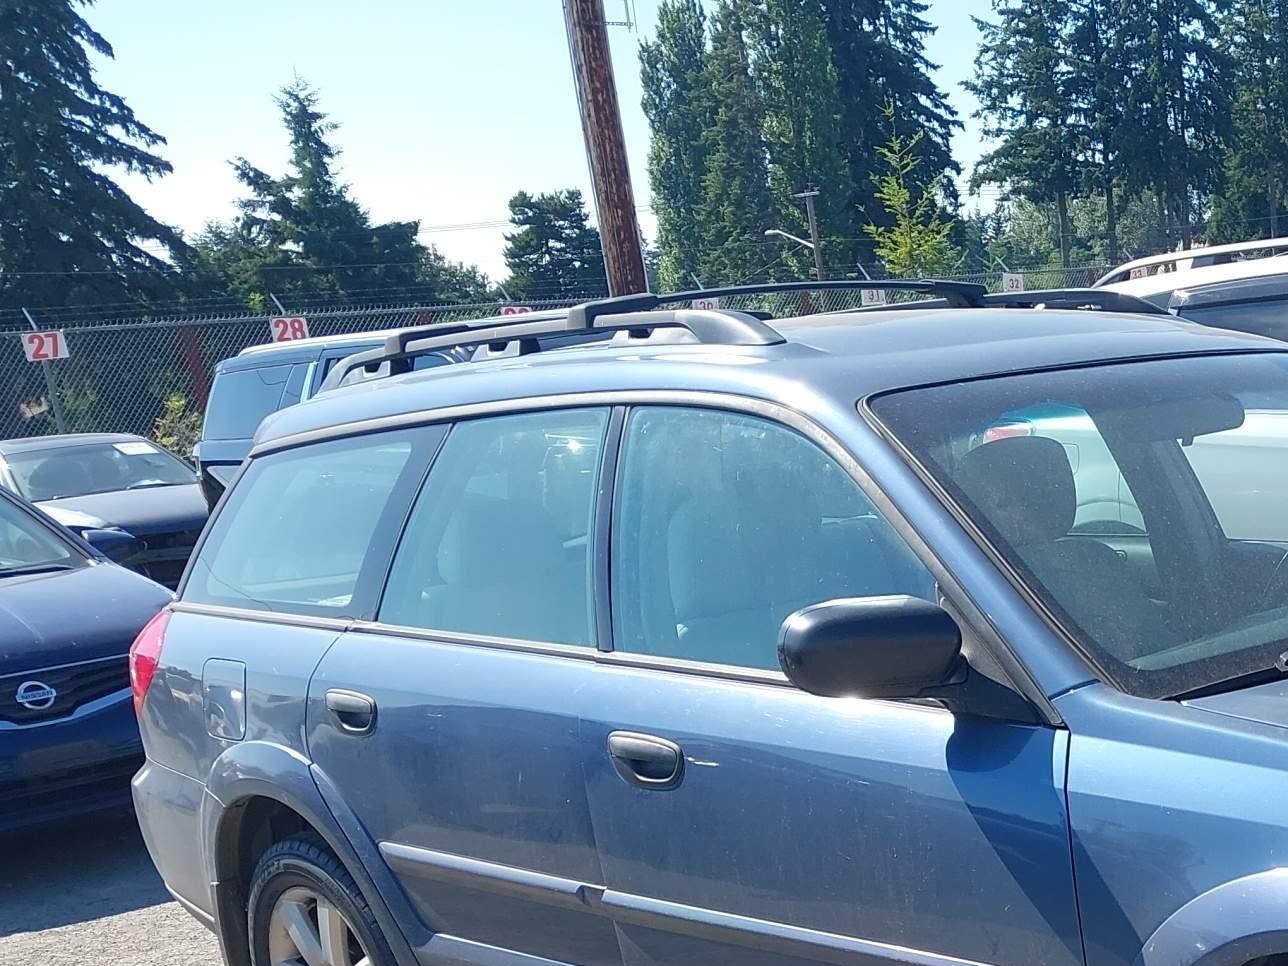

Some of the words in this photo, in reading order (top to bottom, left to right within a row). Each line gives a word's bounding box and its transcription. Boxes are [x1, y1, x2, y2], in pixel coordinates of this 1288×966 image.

[1009, 278, 1020, 289] 32
[274, 319, 305, 341] 28
[28, 333, 59, 360] 27
